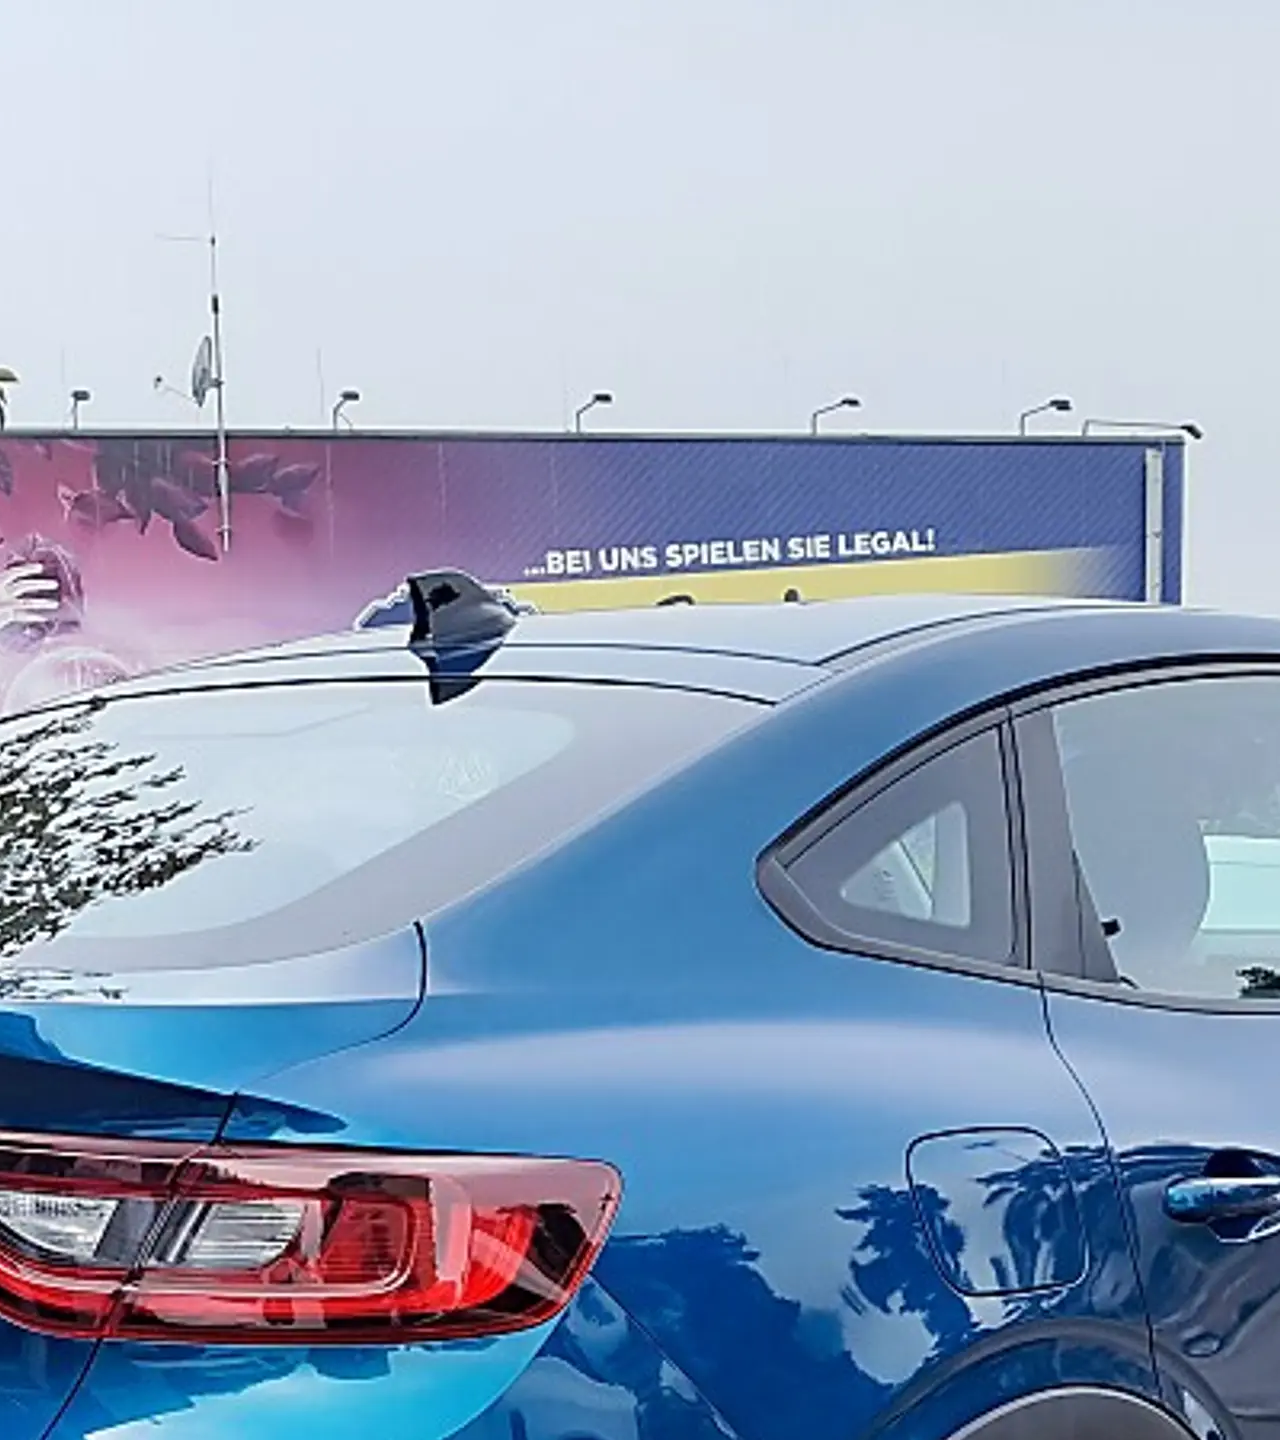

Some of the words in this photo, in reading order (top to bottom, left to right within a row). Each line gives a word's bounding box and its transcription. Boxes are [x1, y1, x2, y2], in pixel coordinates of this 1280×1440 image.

[599, 545, 657, 572] UNS
[665, 537, 780, 568] SPIELEN
[788, 532, 831, 560] SIE
[838, 527, 936, 556] LEGAL!
